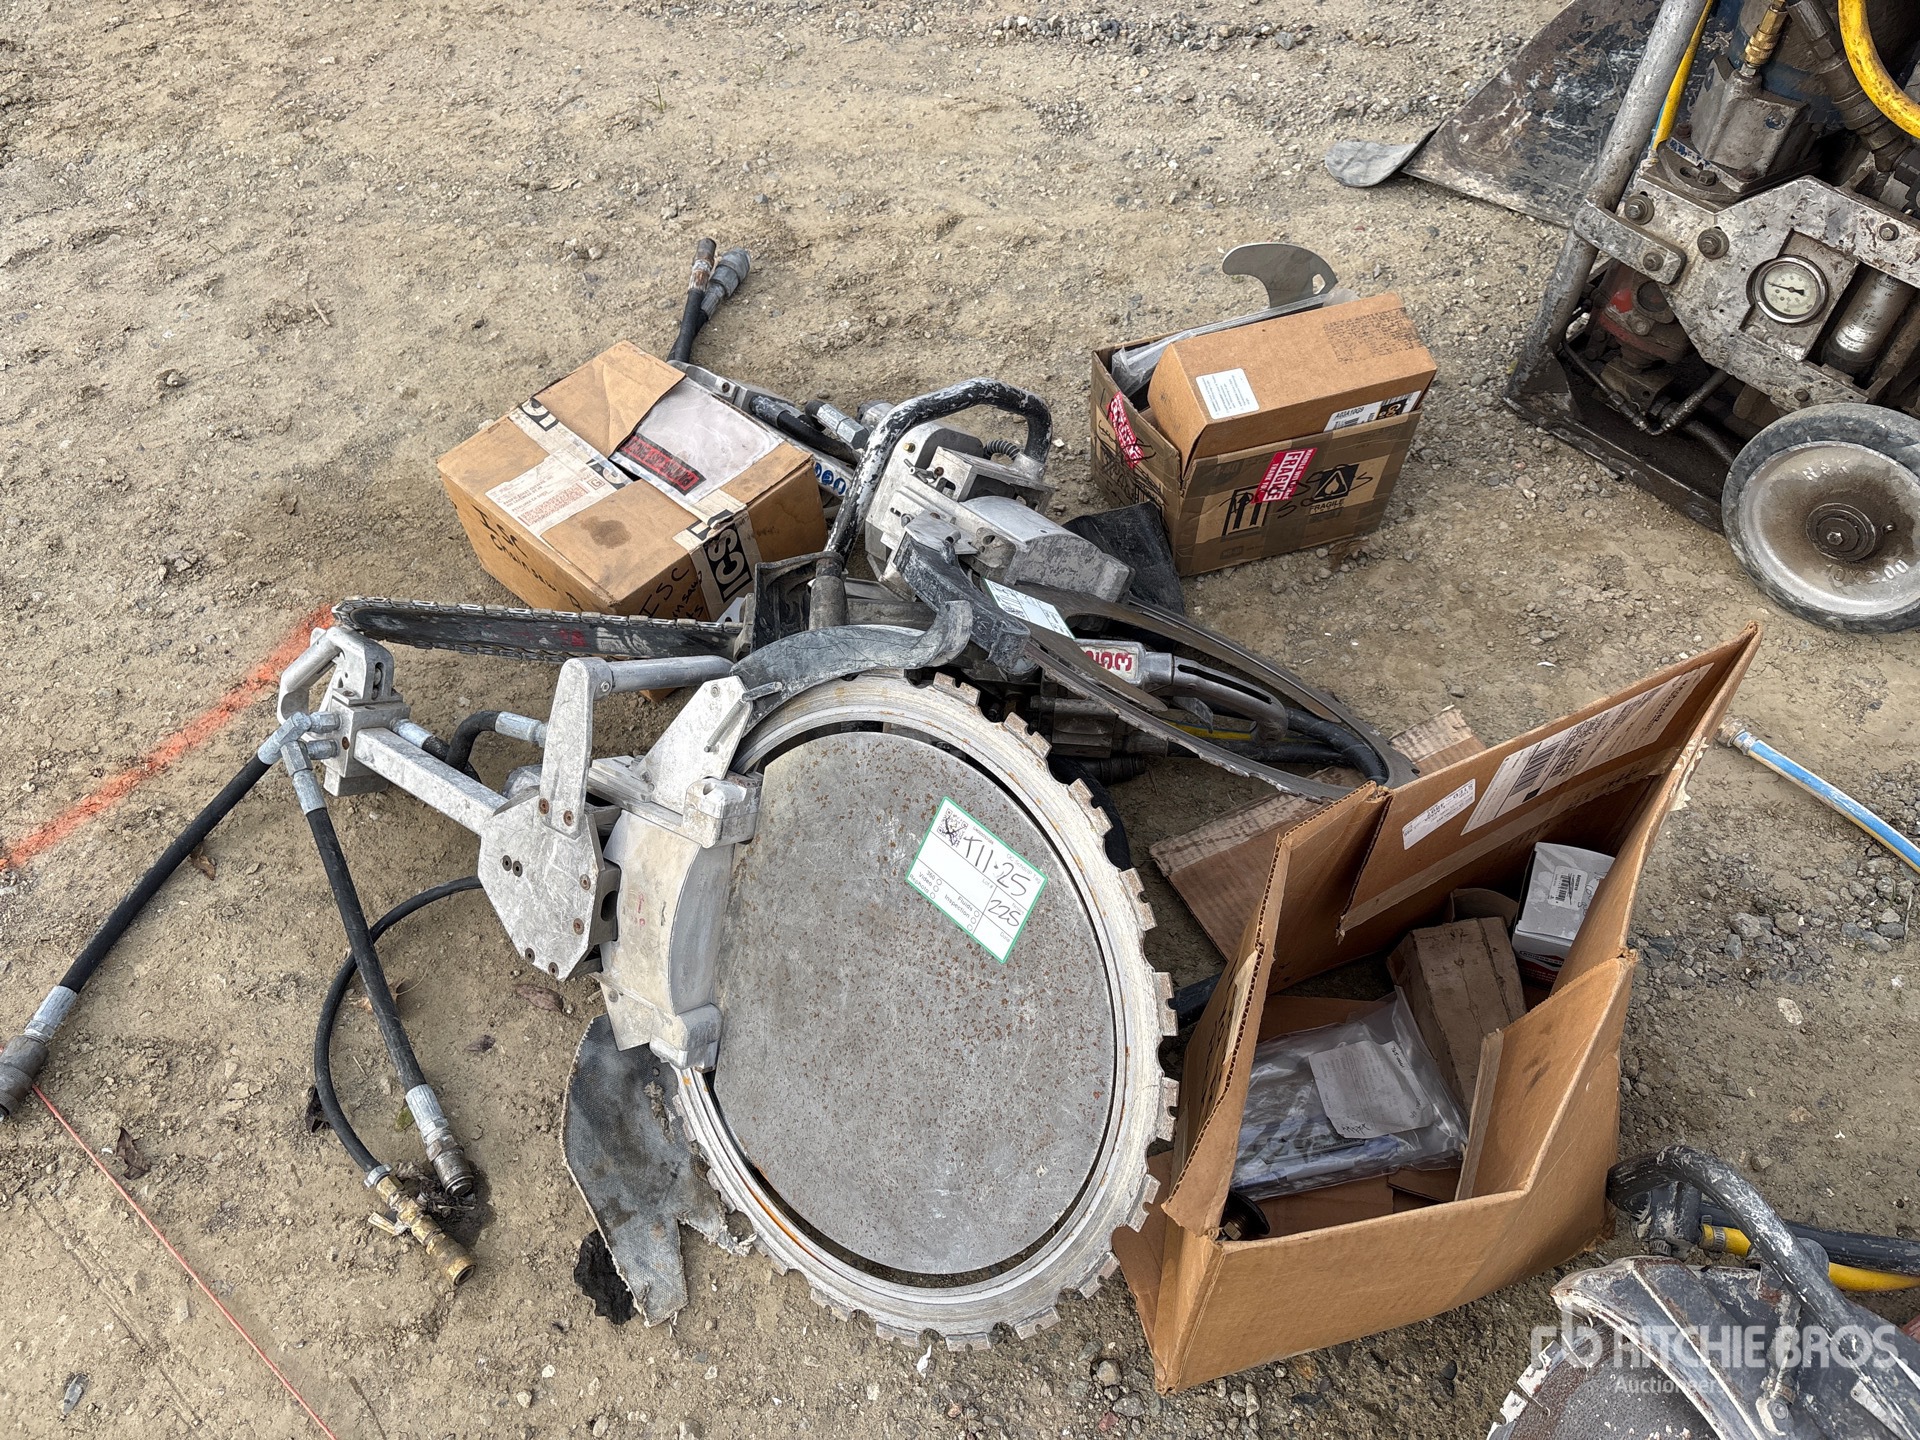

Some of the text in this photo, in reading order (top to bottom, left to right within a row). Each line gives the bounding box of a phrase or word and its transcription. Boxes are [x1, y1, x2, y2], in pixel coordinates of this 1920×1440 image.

[590, 478, 602, 488] G
[1267, 453, 1301, 500] FRAGILE
[1310, 500, 1343, 511] FRAGILE
[708, 530, 751, 600] ICS
[908, 873, 930, 894] Rephoto
[917, 871, 933, 887] Video
[944, 894, 971, 919] Inspection
[957, 896, 973, 911] Fluids
[988, 900, 1021, 926] 225
